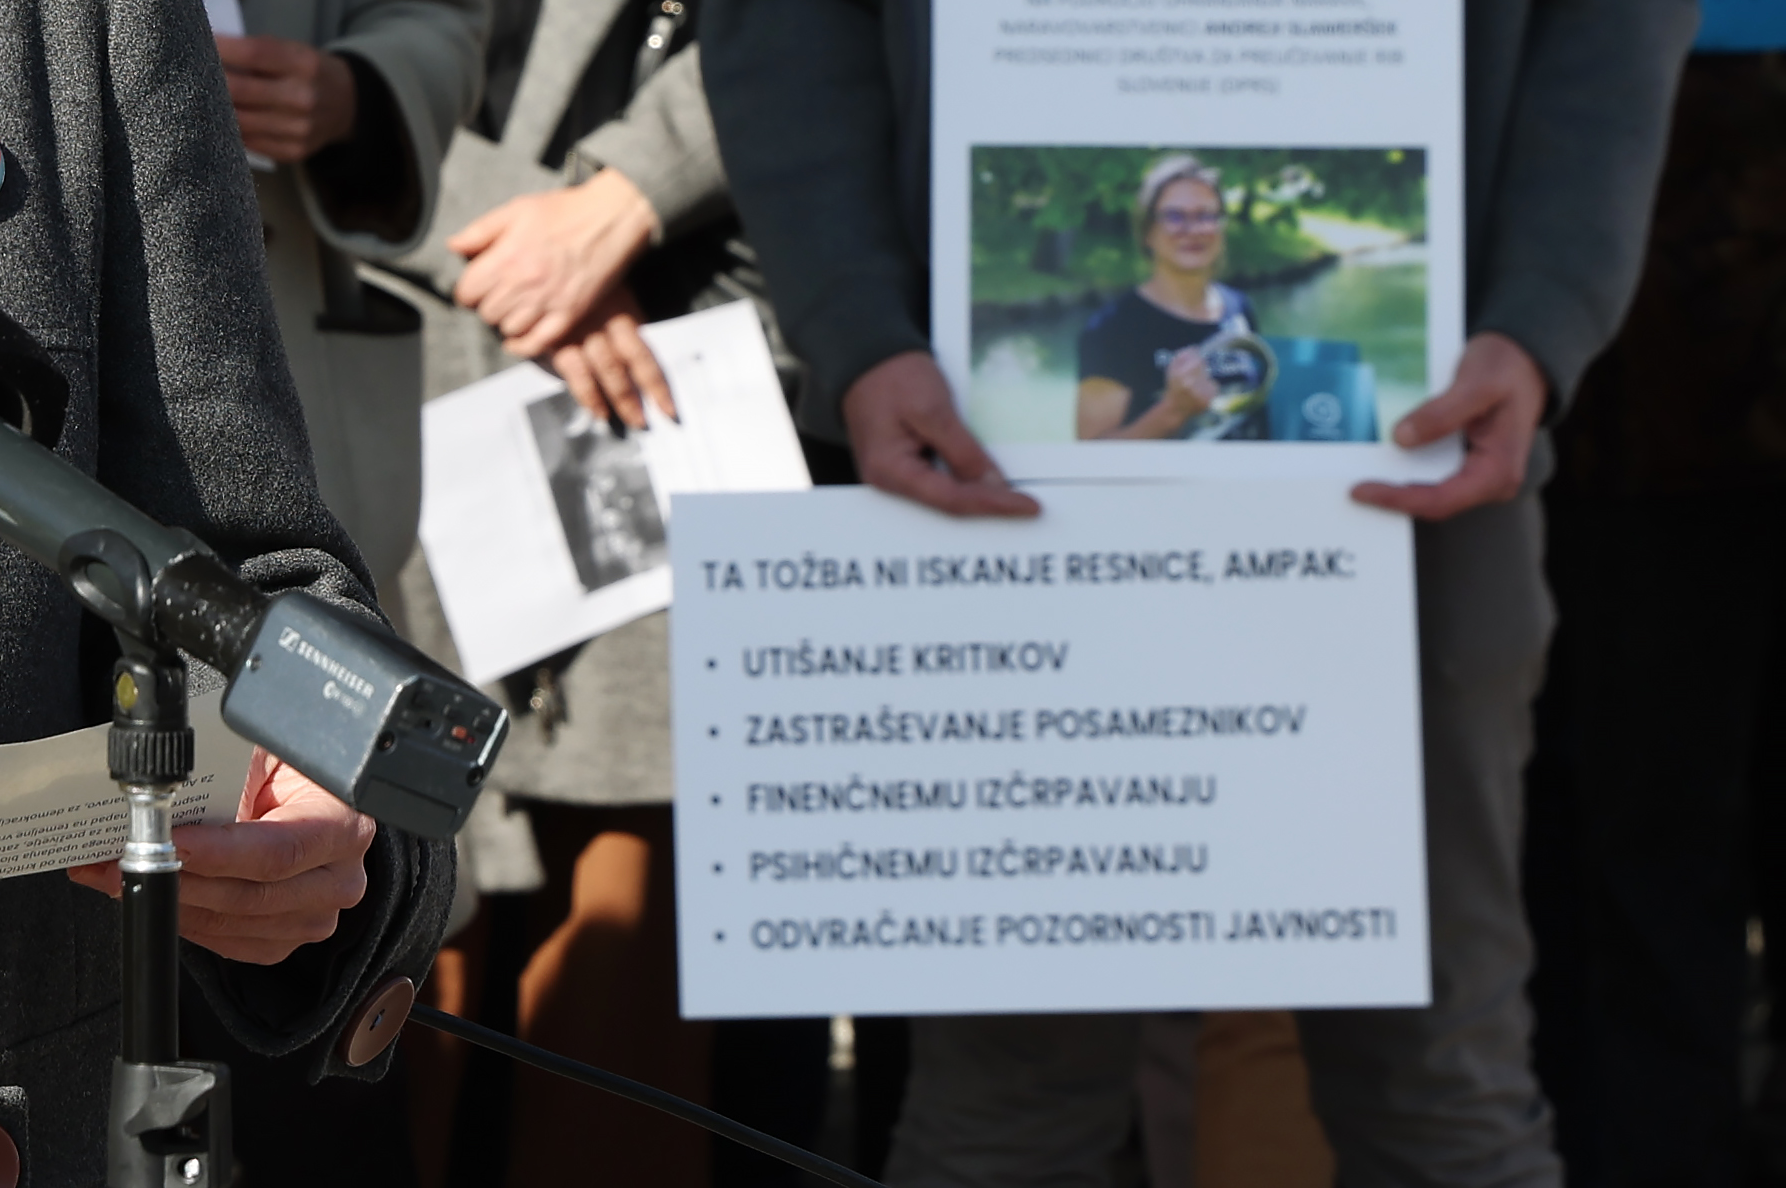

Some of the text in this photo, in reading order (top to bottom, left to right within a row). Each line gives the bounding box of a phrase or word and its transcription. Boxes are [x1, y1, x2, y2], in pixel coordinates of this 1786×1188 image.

[703, 548, 1356, 592] TA TOŽBA NI ISKANJE RESNICE, AMPAK:
[297, 641, 375, 700] SENNHEISER
[743, 641, 1070, 679] UTIŠANJE KRITIKOV
[746, 704, 1307, 747] ZASTRAŠEVANJE POSAMEZNIKOV
[170, 792, 210, 808] nespre
[171, 805, 207, 820] ključn
[746, 771, 1218, 814] FINENČNEMU IZČRPAVANJU
[749, 840, 1209, 883] PSIHIČNEMU IZČRPAVANJU
[751, 908, 1397, 952] ODVRAČANJE POZORNOSTI JAVNOSTI
